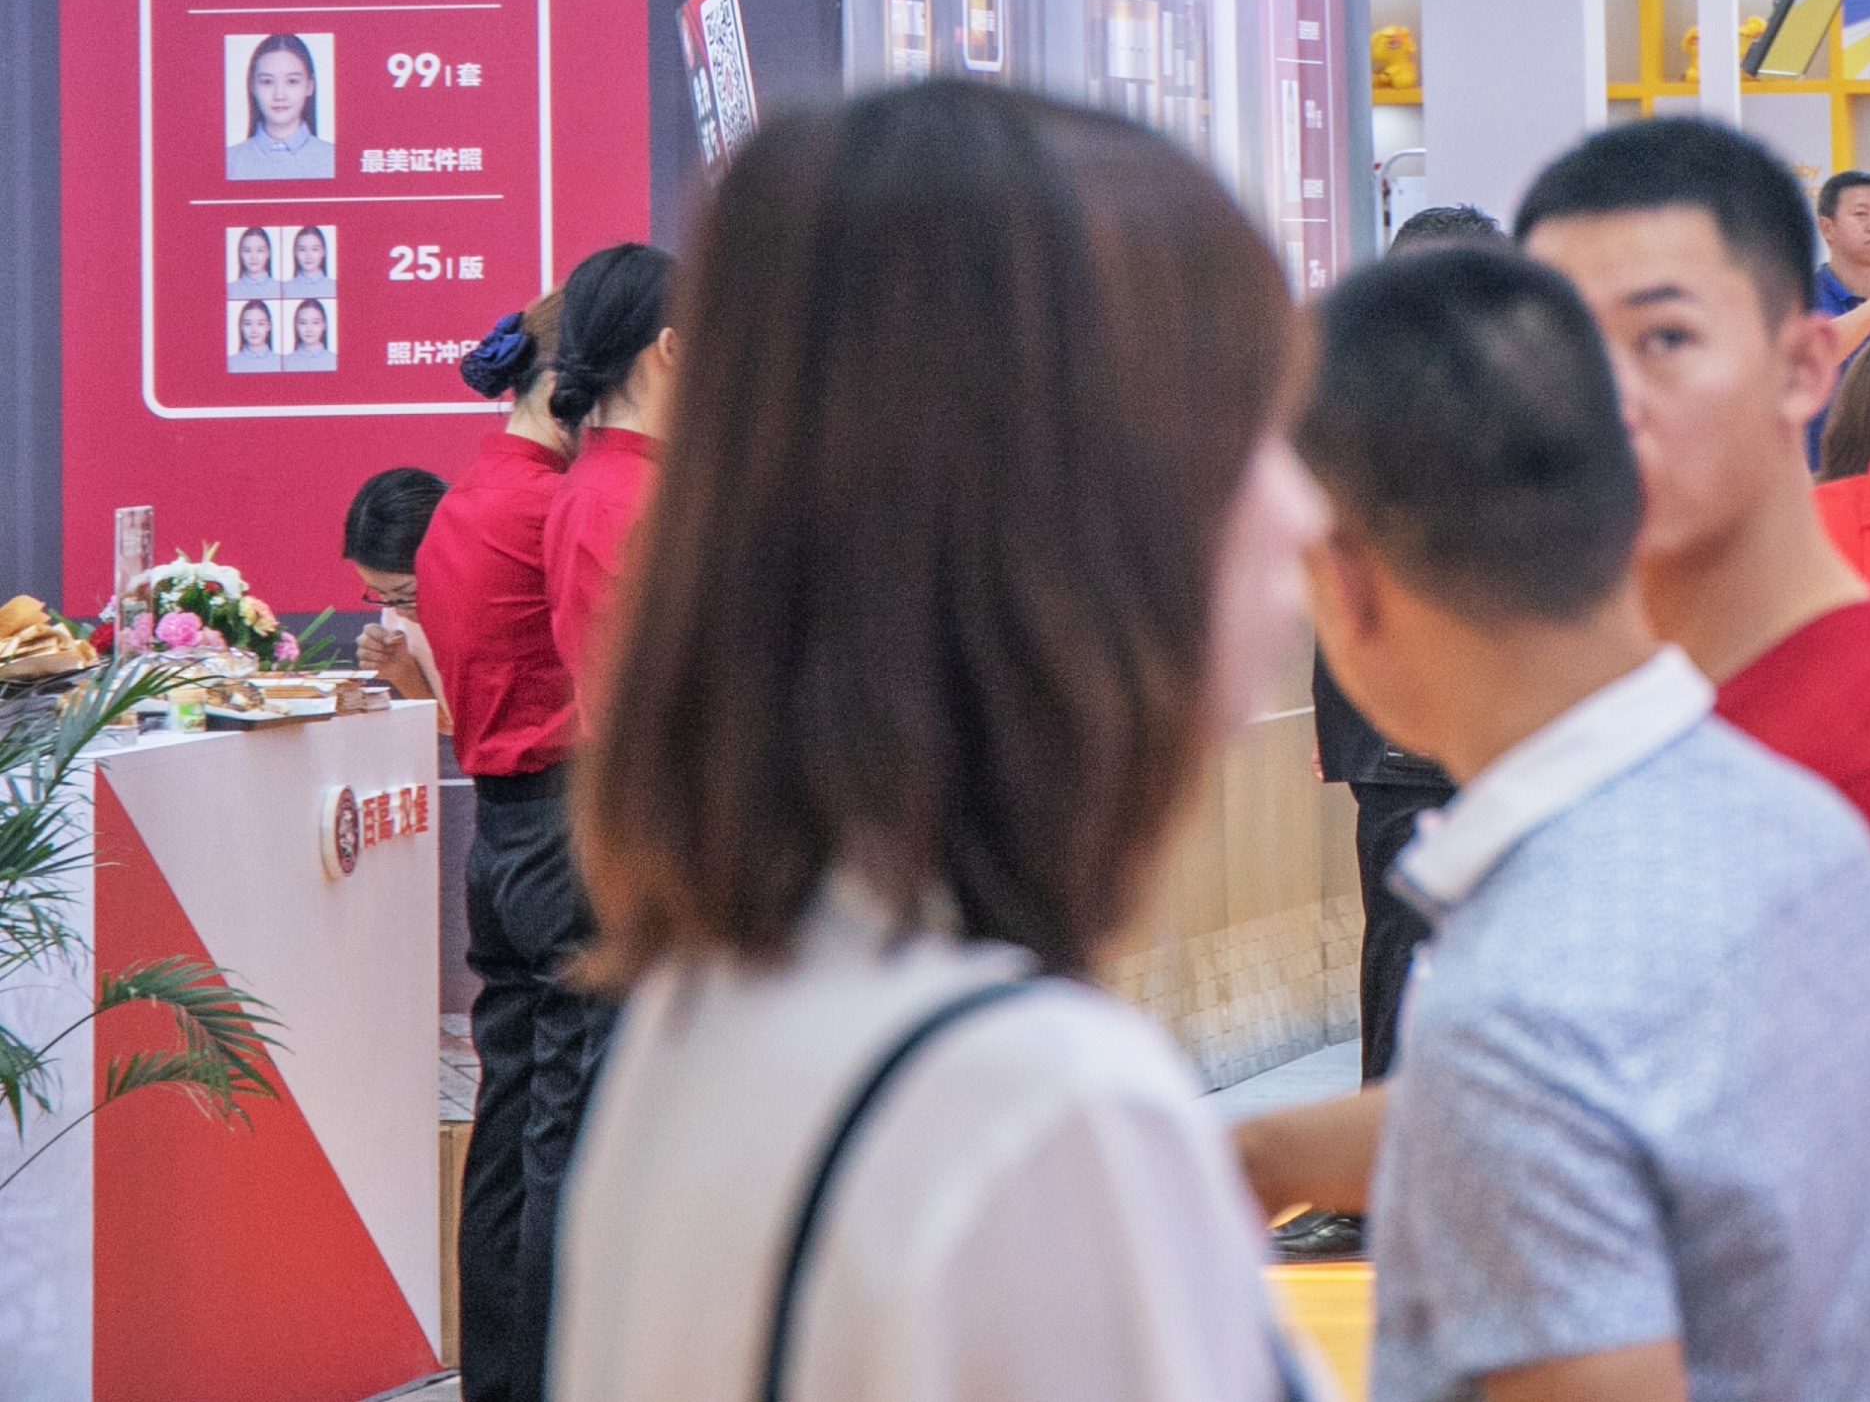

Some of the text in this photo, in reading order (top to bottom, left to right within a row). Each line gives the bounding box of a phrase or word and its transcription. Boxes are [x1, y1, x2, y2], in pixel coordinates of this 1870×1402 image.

[360, 147, 483, 173] 最美证件照
